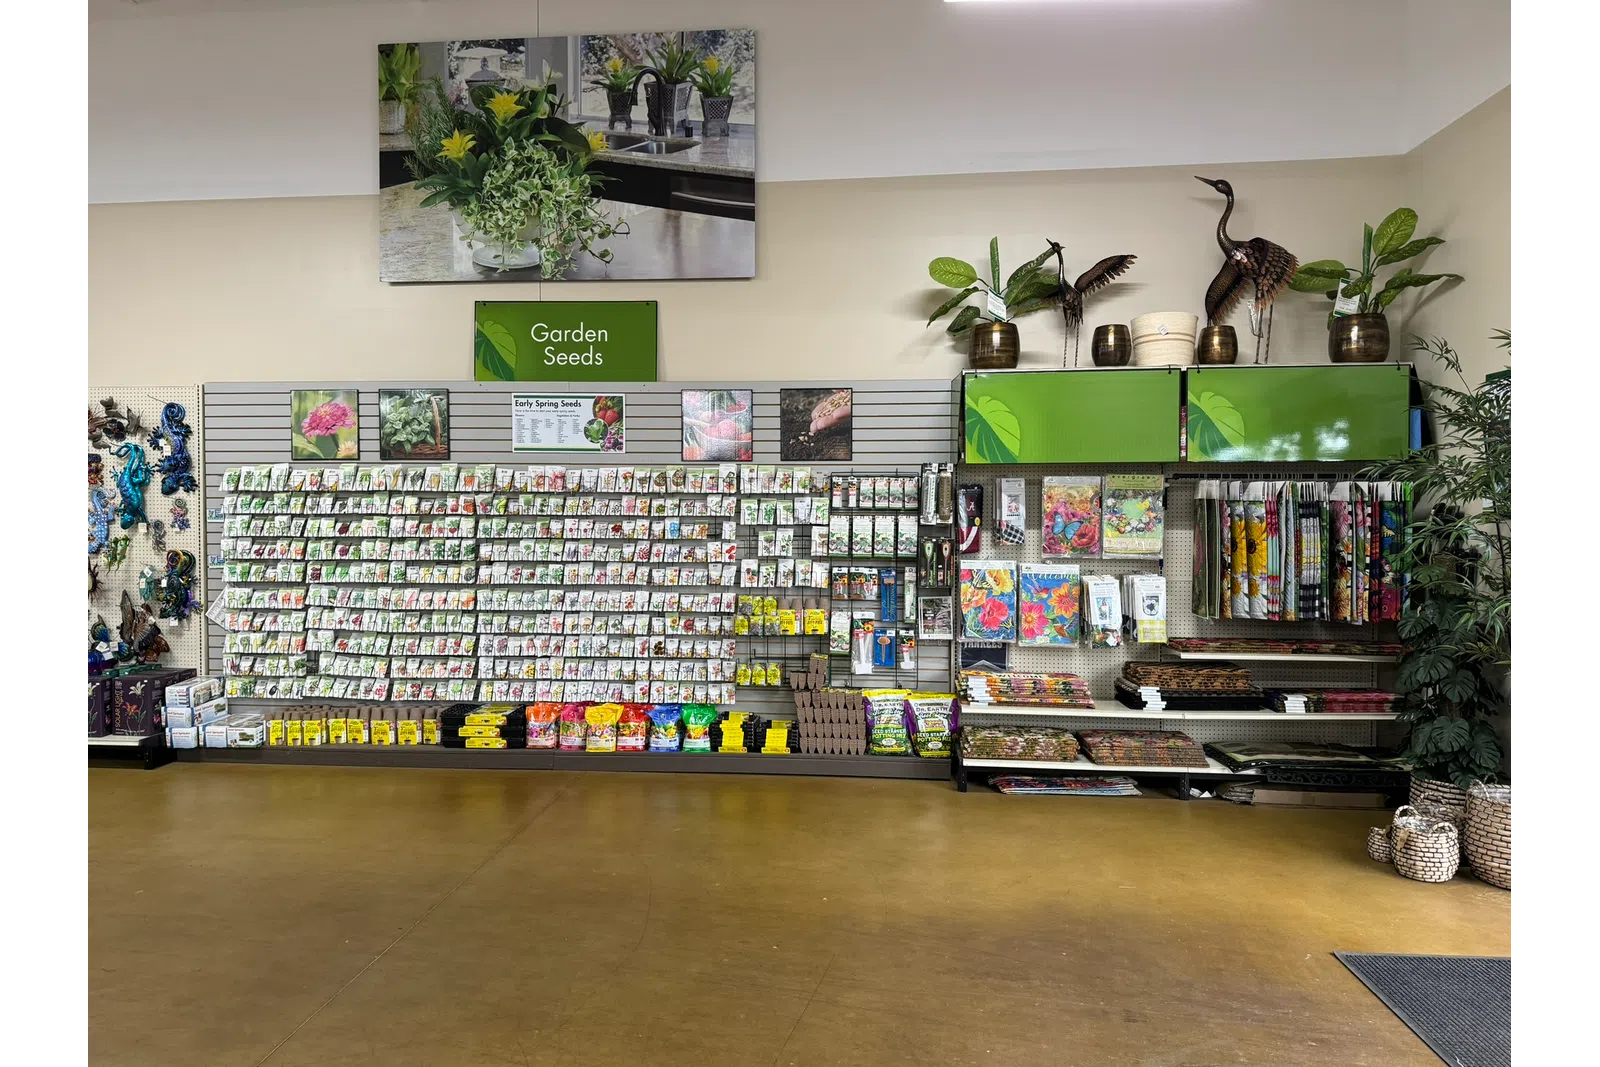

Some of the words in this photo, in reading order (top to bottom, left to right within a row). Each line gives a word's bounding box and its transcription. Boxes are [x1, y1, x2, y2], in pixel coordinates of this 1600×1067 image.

[531, 322, 608, 342] Garden
[544, 346, 603, 366] Seeds
[515, 400, 533, 408] Early
[536, 400, 559, 409] Spring
